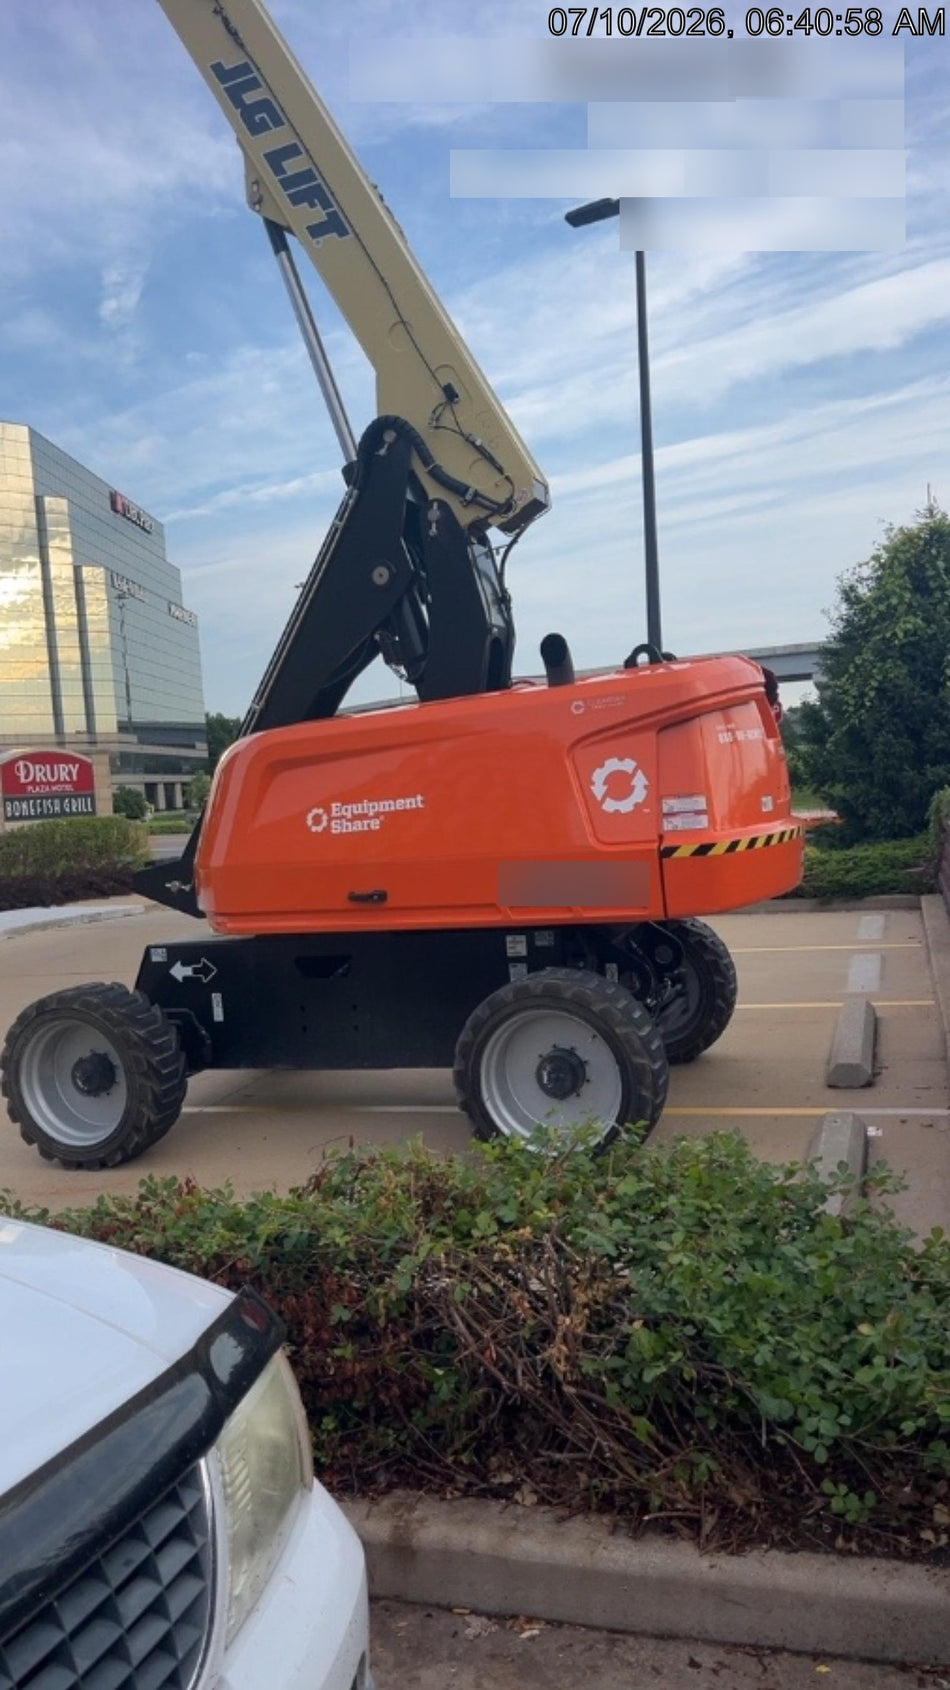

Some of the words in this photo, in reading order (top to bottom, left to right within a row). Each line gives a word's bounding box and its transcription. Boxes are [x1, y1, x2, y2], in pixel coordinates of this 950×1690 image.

[209, 60, 287, 138] JLG
[262, 141, 351, 240] LIFT
[14, 760, 80, 784] DRURY
[26, 784, 50, 793] PLAZA
[5, 798, 61, 817] BONEFISH
[63, 797, 93, 813] GRILL
[331, 794, 425, 819] Equipment
[331, 818, 381, 834] Share
